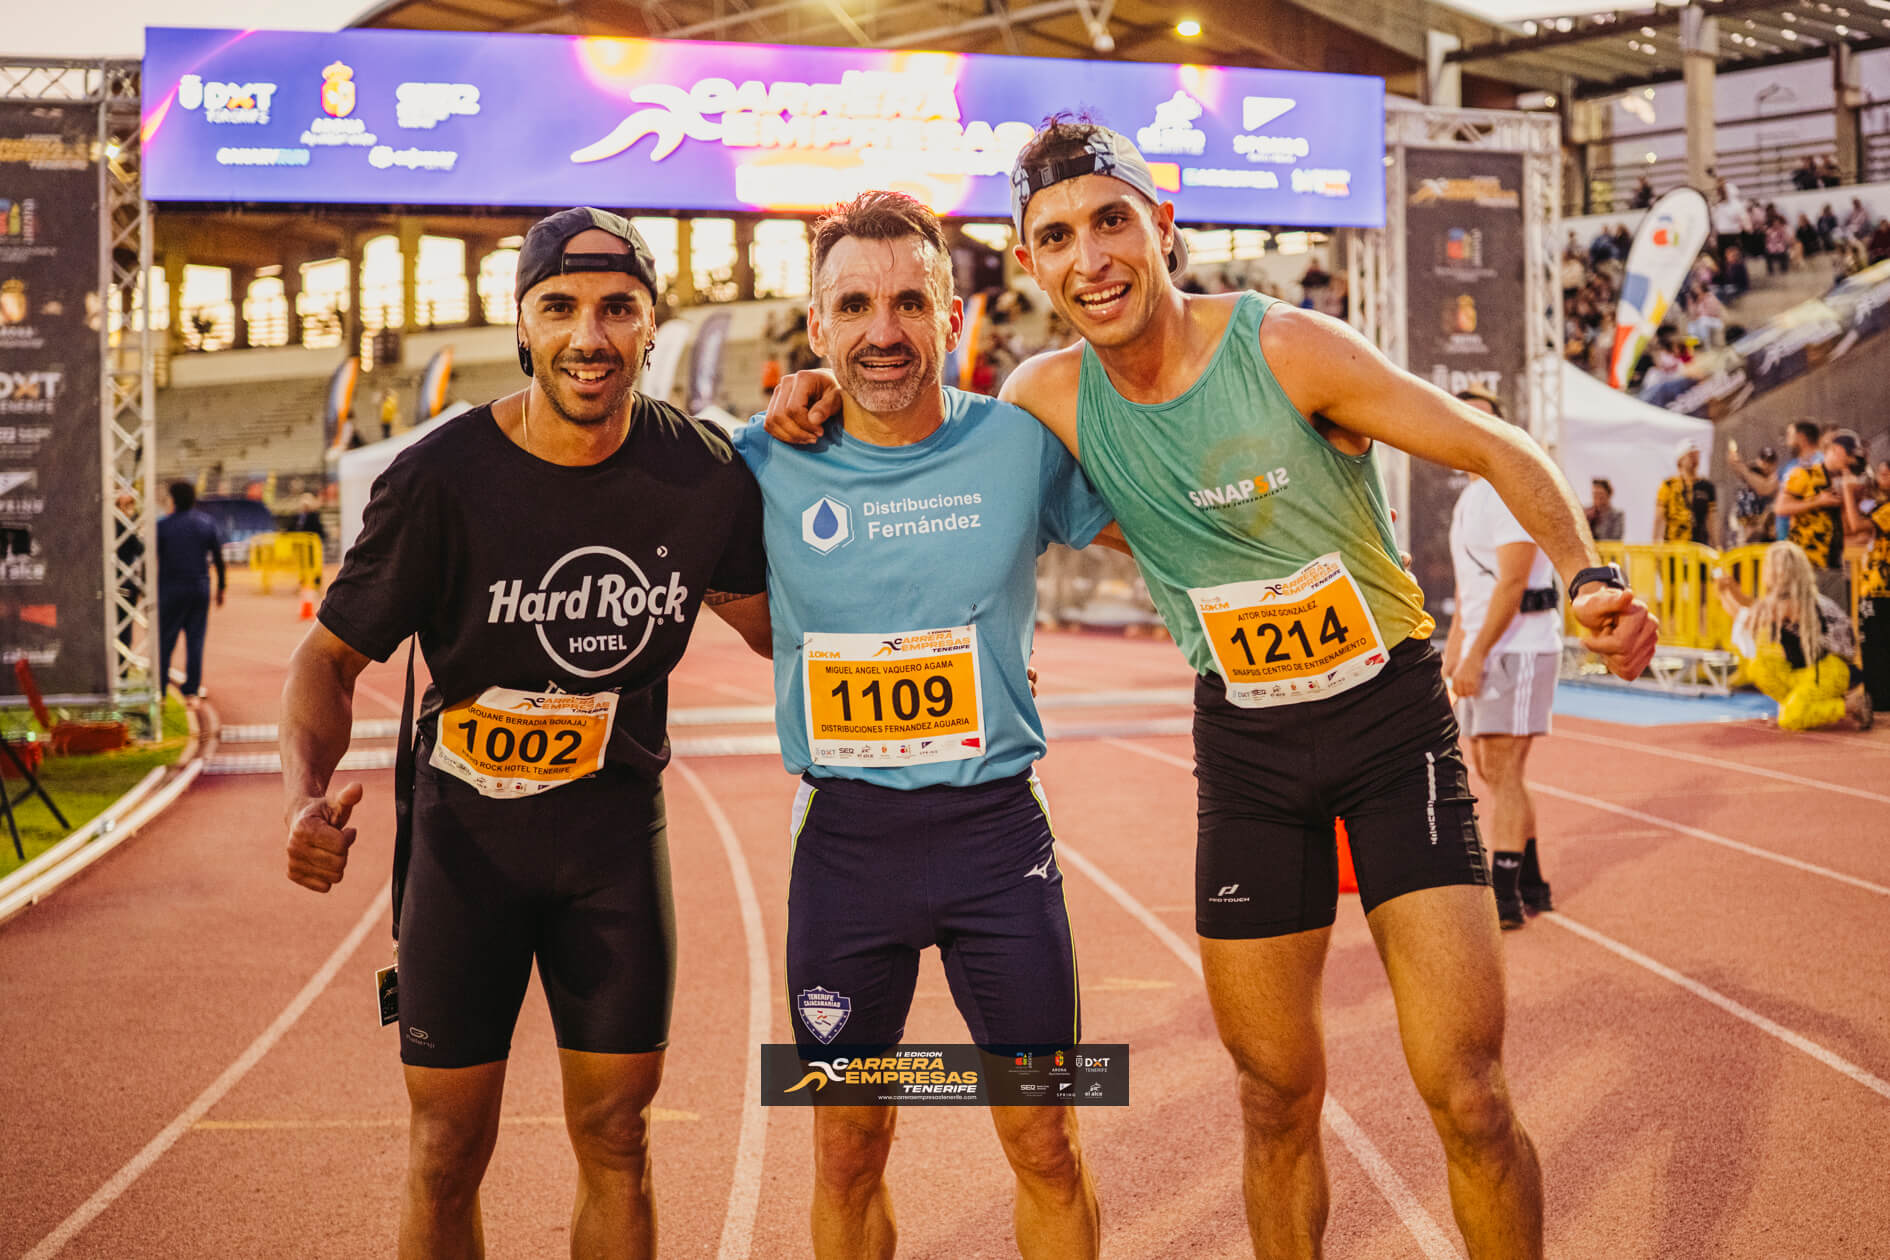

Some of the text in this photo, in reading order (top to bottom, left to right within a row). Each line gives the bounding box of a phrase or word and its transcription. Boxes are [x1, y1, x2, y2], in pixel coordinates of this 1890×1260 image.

[864, 493, 982, 516] Distribuciones
[867, 513, 981, 540] Fernández
[487, 571, 688, 627] Hard Rock
[1238, 611, 1260, 621] AITOR
[568, 634, 628, 653] HOTEL
[901, 637, 971, 652] EMPRESAS
[1230, 606, 1349, 666] 1214
[808, 650, 841, 658] 10KM
[932, 645, 971, 653] TENERIFE
[1232, 637, 1367, 676] SINAPSIS CENTRO DE ENTRENAMIENTO
[825, 660, 954, 674] MIGUEL ANGEL VAQUERO AGAMA
[831, 675, 953, 722] 1109
[506, 716, 547, 726] BERRADIA
[821, 718, 970, 734] DISTRIBUCIONES FERNANDEZ AGUARIA
[458, 719, 582, 766] 1002
[479, 762, 502, 771] ROCK
[534, 766, 570, 775] TENERIFE
